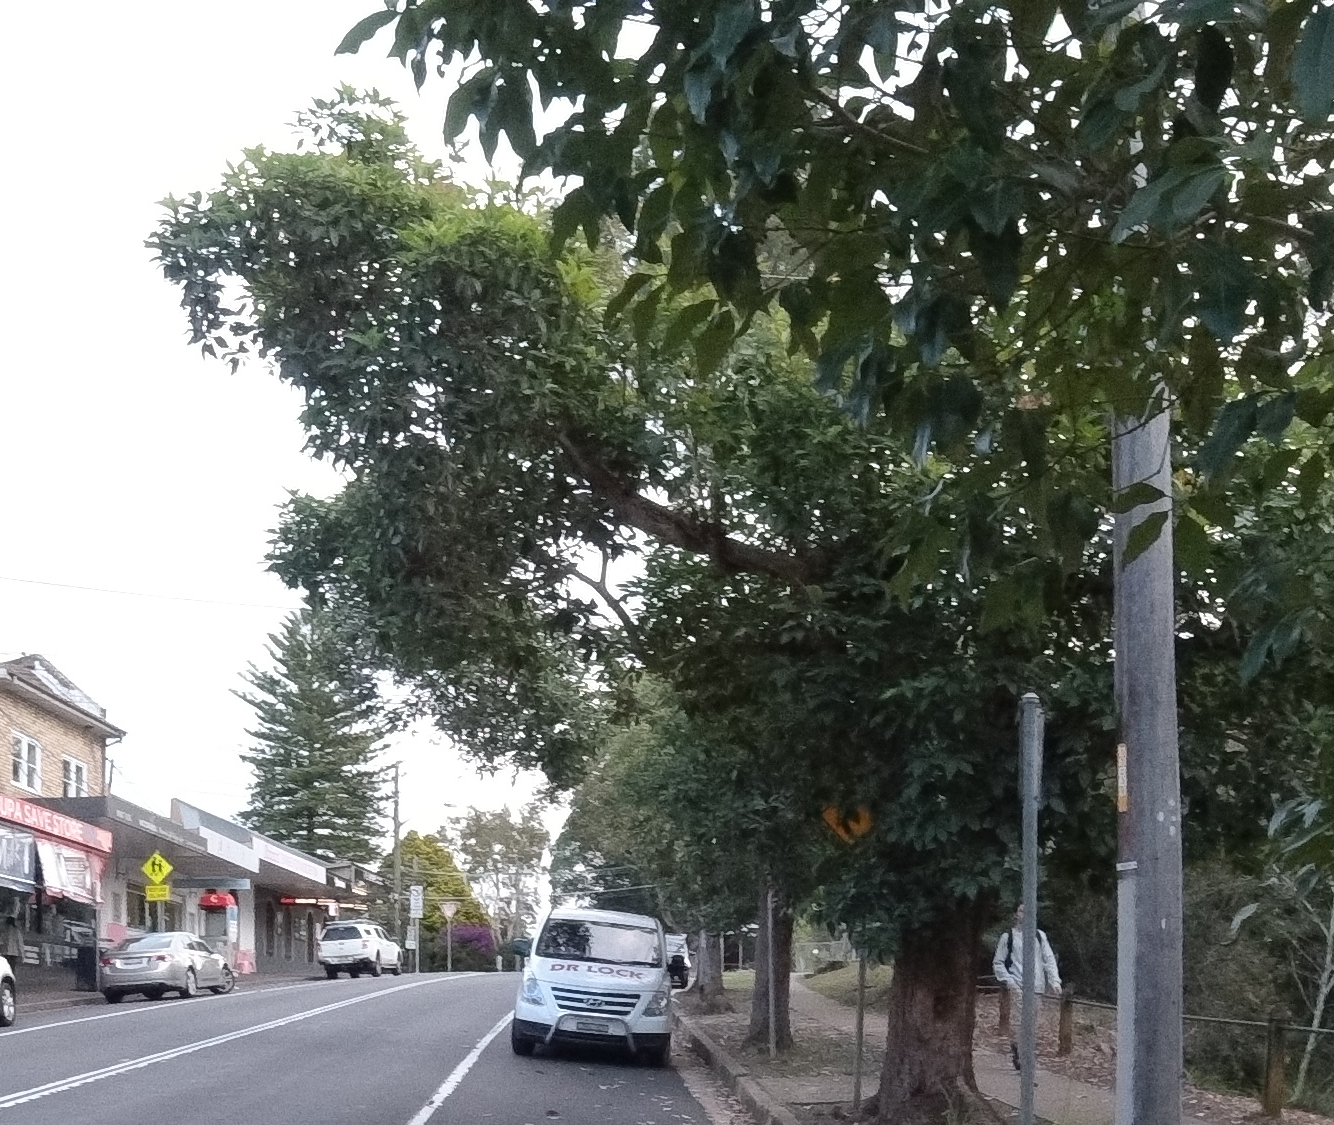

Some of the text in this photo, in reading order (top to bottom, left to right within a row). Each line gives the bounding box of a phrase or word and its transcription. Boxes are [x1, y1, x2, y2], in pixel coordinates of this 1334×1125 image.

[24, 805, 52, 830] SAVE
[53, 814, 84, 841] STORE
[549, 963, 644, 979] DR LOCK
